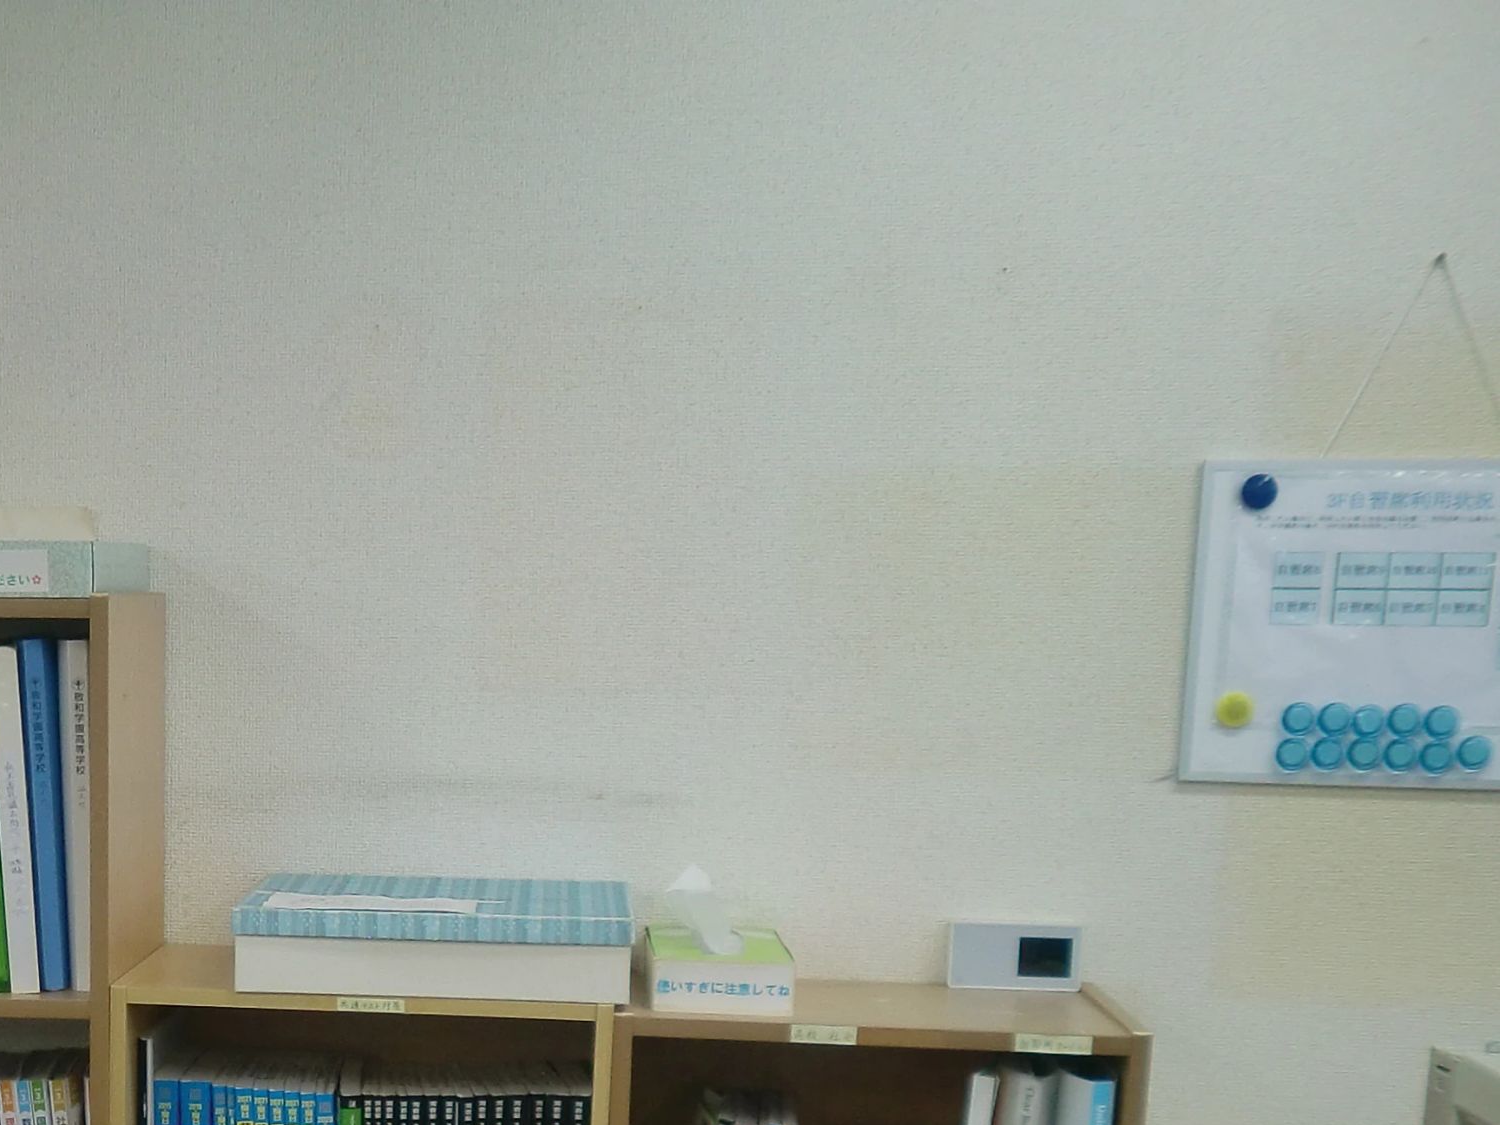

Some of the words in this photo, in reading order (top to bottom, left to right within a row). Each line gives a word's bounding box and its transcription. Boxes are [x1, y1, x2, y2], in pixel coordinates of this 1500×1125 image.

[656, 977, 791, 998] 使いすぎに注意してね
